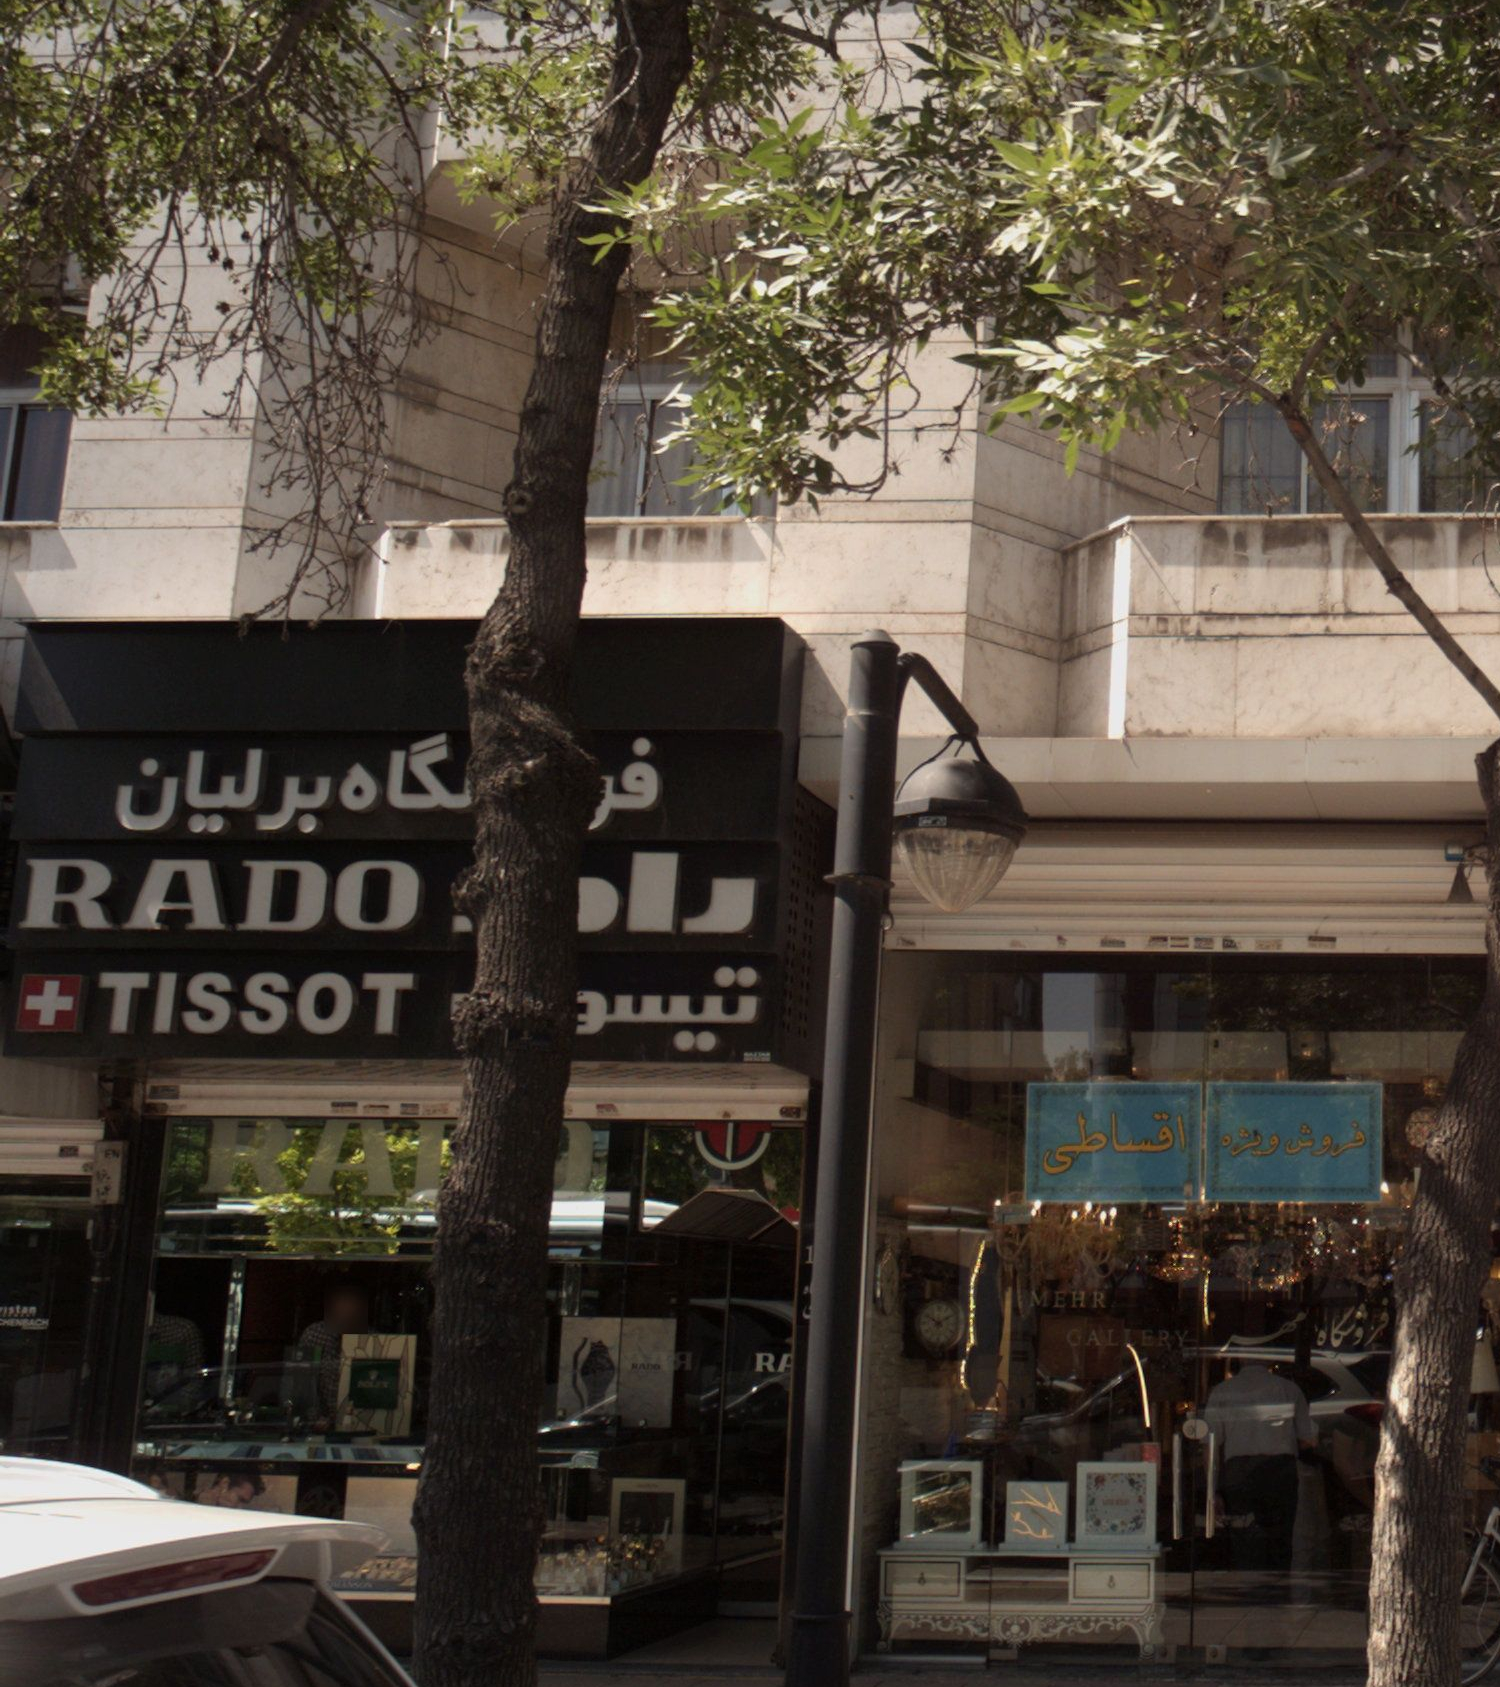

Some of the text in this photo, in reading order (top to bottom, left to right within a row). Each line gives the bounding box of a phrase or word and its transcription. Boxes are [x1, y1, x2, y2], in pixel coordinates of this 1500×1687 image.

[115, 732, 661, 833] فرگاه برلیان
[19, 857, 424, 933] RADO
[98, 972, 416, 1035] TISSOT
[1042, 1111, 1188, 1175] اقساطی
[1221, 1120, 1366, 1158] فروش ویژه
[1030, 1290, 1107, 1309] MEHR
[1314, 1297, 1390, 1348] فروشگاه
[1066, 1328, 1190, 1348] GALLERY
